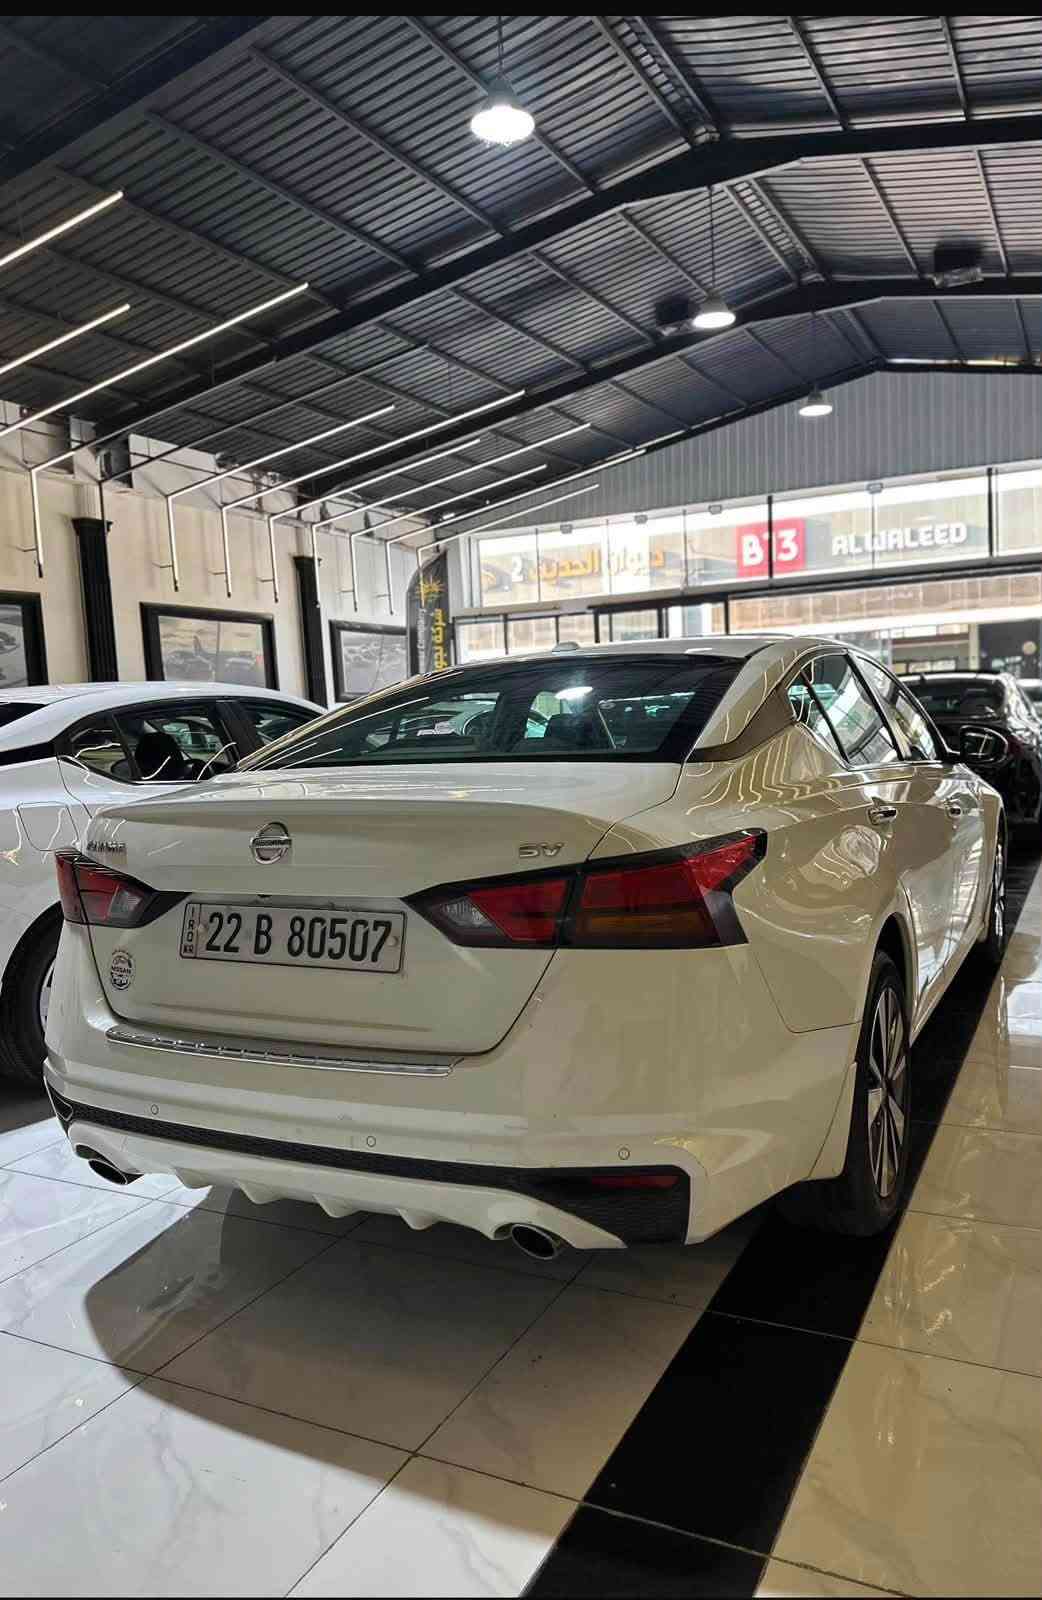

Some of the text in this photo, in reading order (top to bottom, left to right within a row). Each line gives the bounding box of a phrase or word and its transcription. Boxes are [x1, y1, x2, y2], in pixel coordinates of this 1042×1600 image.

[518, 842, 563, 859] SV
[206, 912, 393, 963] 22 B 80507
